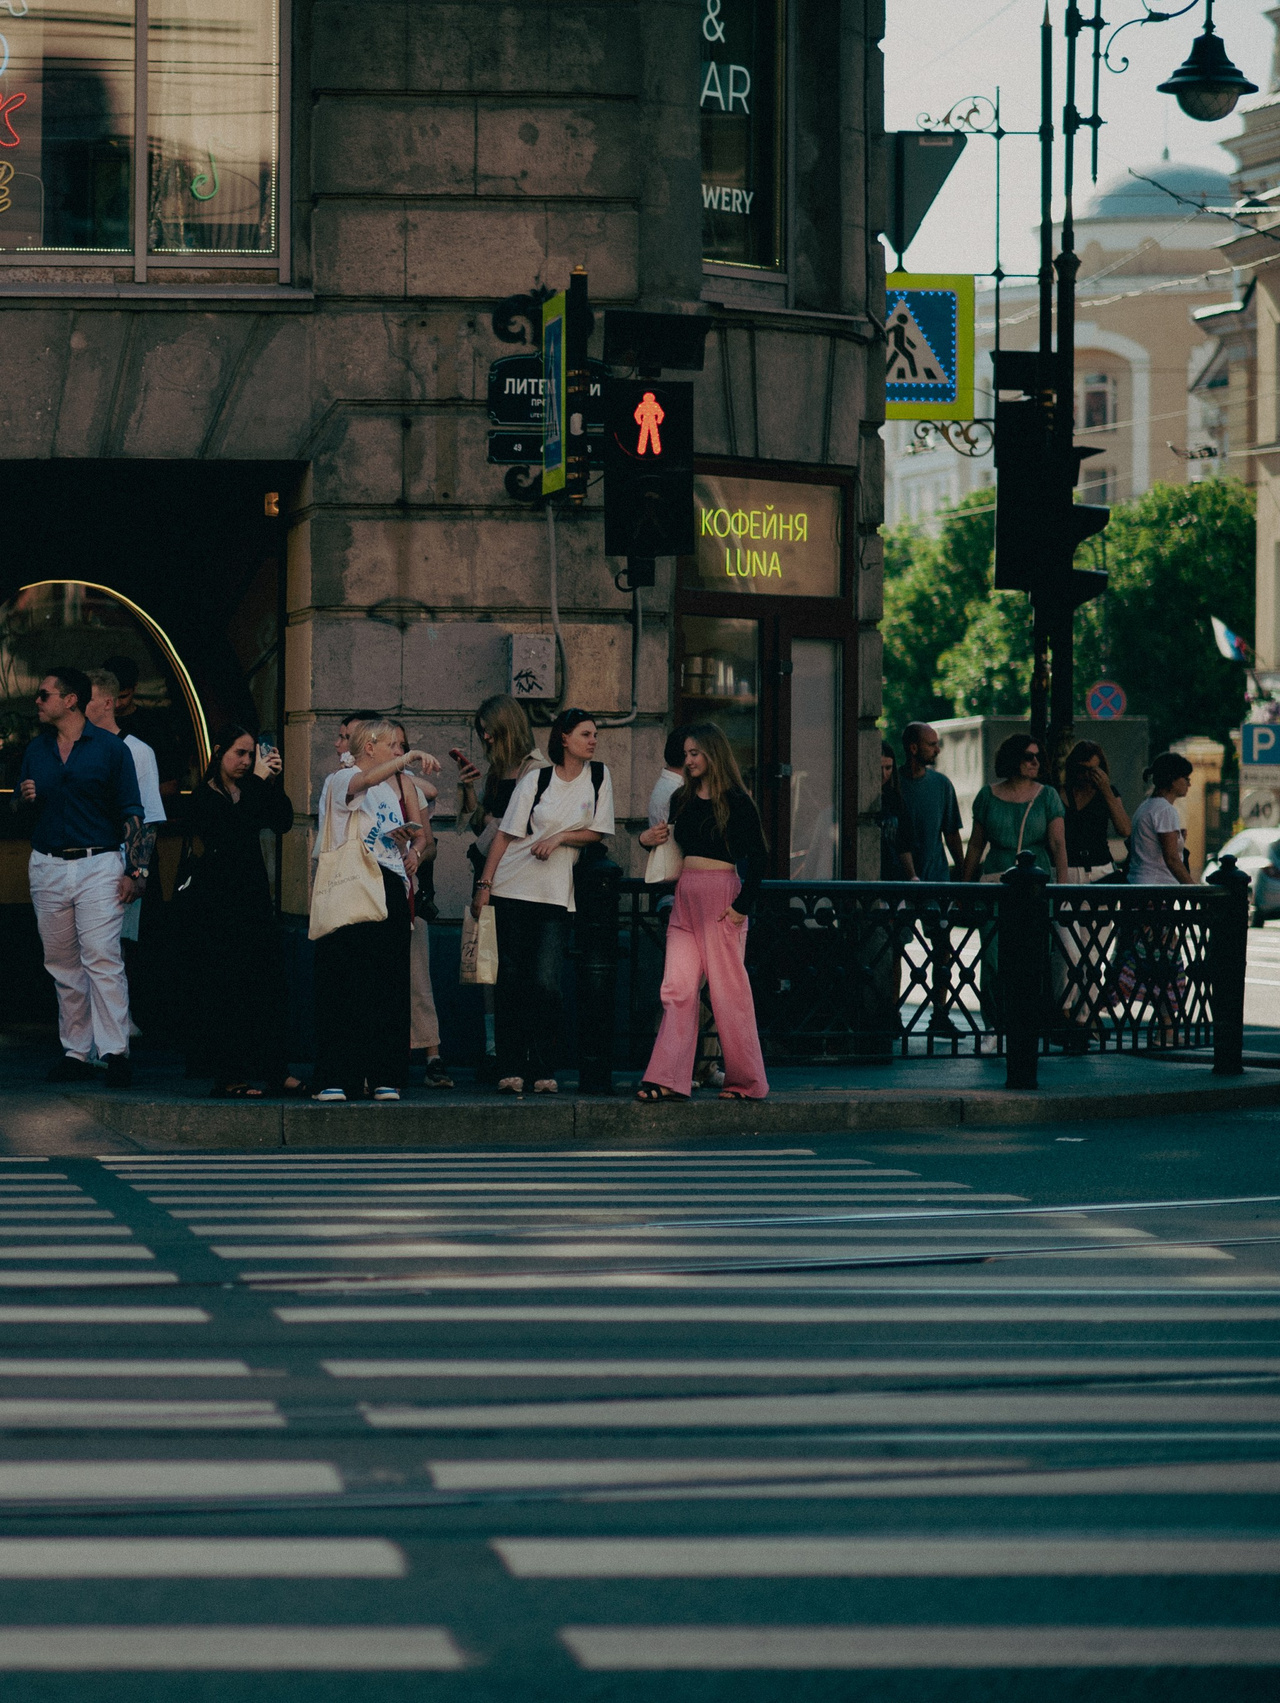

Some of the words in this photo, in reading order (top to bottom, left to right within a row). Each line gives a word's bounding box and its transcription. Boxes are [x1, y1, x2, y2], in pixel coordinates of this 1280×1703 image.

[702, 0, 726, 44] &
[700, 504, 809, 543] КОФЕЙНЯ
[725, 547, 783, 579] LUNA
[1252, 727, 1276, 762] P
